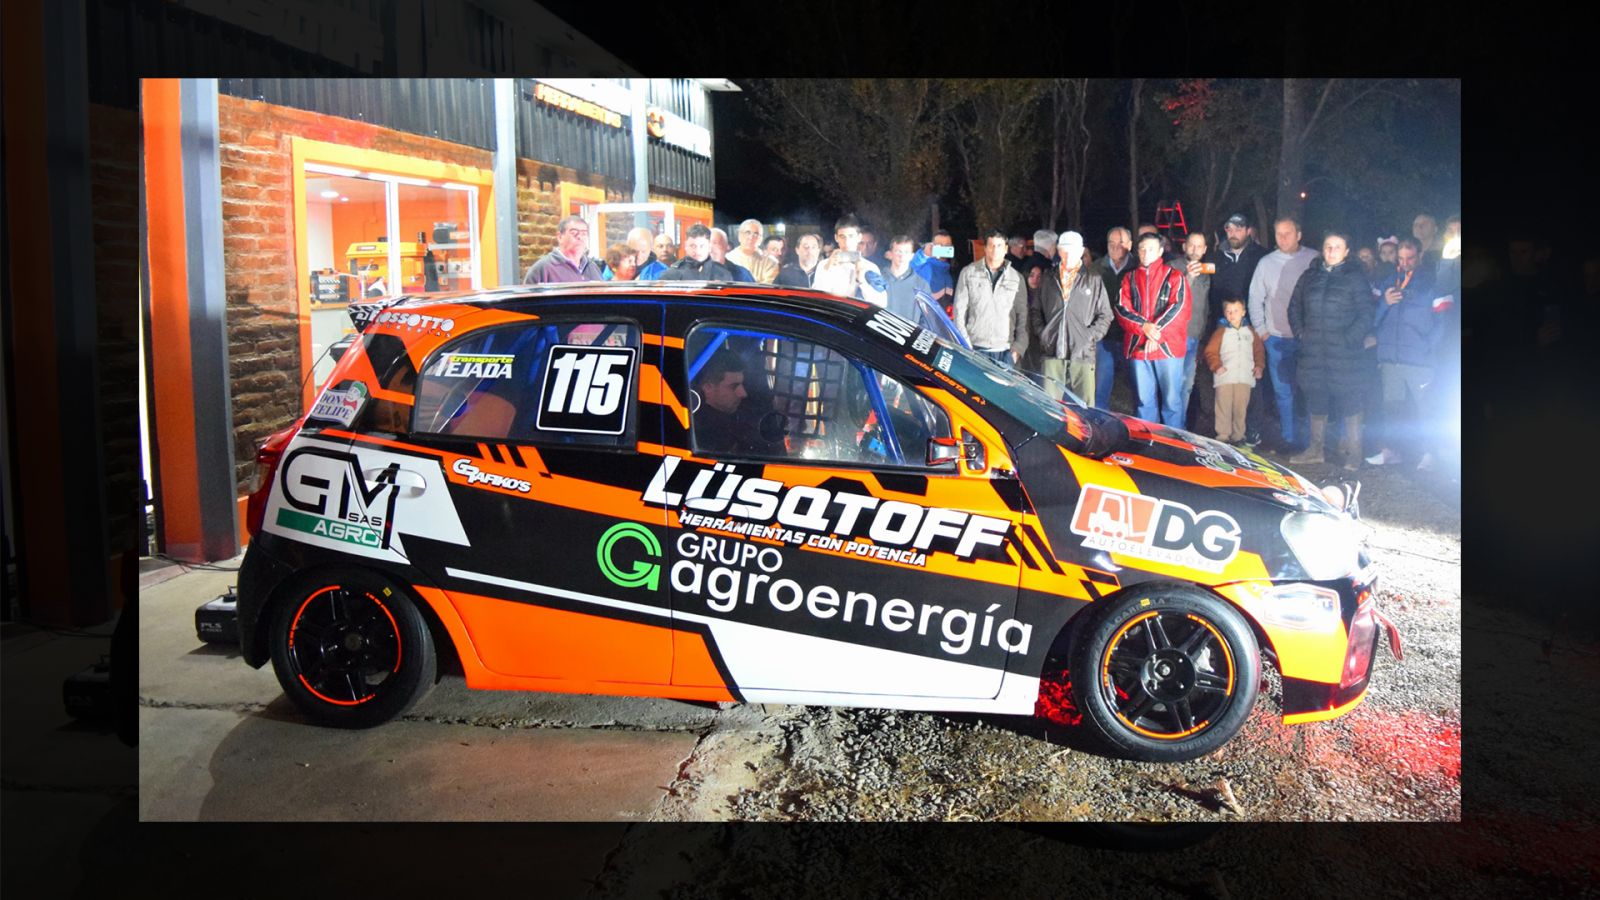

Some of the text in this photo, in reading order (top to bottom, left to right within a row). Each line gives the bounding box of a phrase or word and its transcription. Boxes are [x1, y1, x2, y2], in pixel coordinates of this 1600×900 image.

[434, 352, 515, 379] TEJADA
[451, 355, 514, 364] transporte
[904, 353, 933, 372] Daniel
[934, 371, 968, 395] COSTA
[319, 393, 341, 404] DON
[547, 352, 630, 416] 115
[312, 403, 350, 420] FELIPE
[312, 518, 381, 545] AGRO
[348, 512, 383, 527] SAS
[1152, 503, 1236, 561] DG
[676, 532, 783, 573] GRUPO
[679, 511, 926, 567] HERRAMIENTAS CON POTENCIA
[670, 559, 1033, 656] agroenergía
